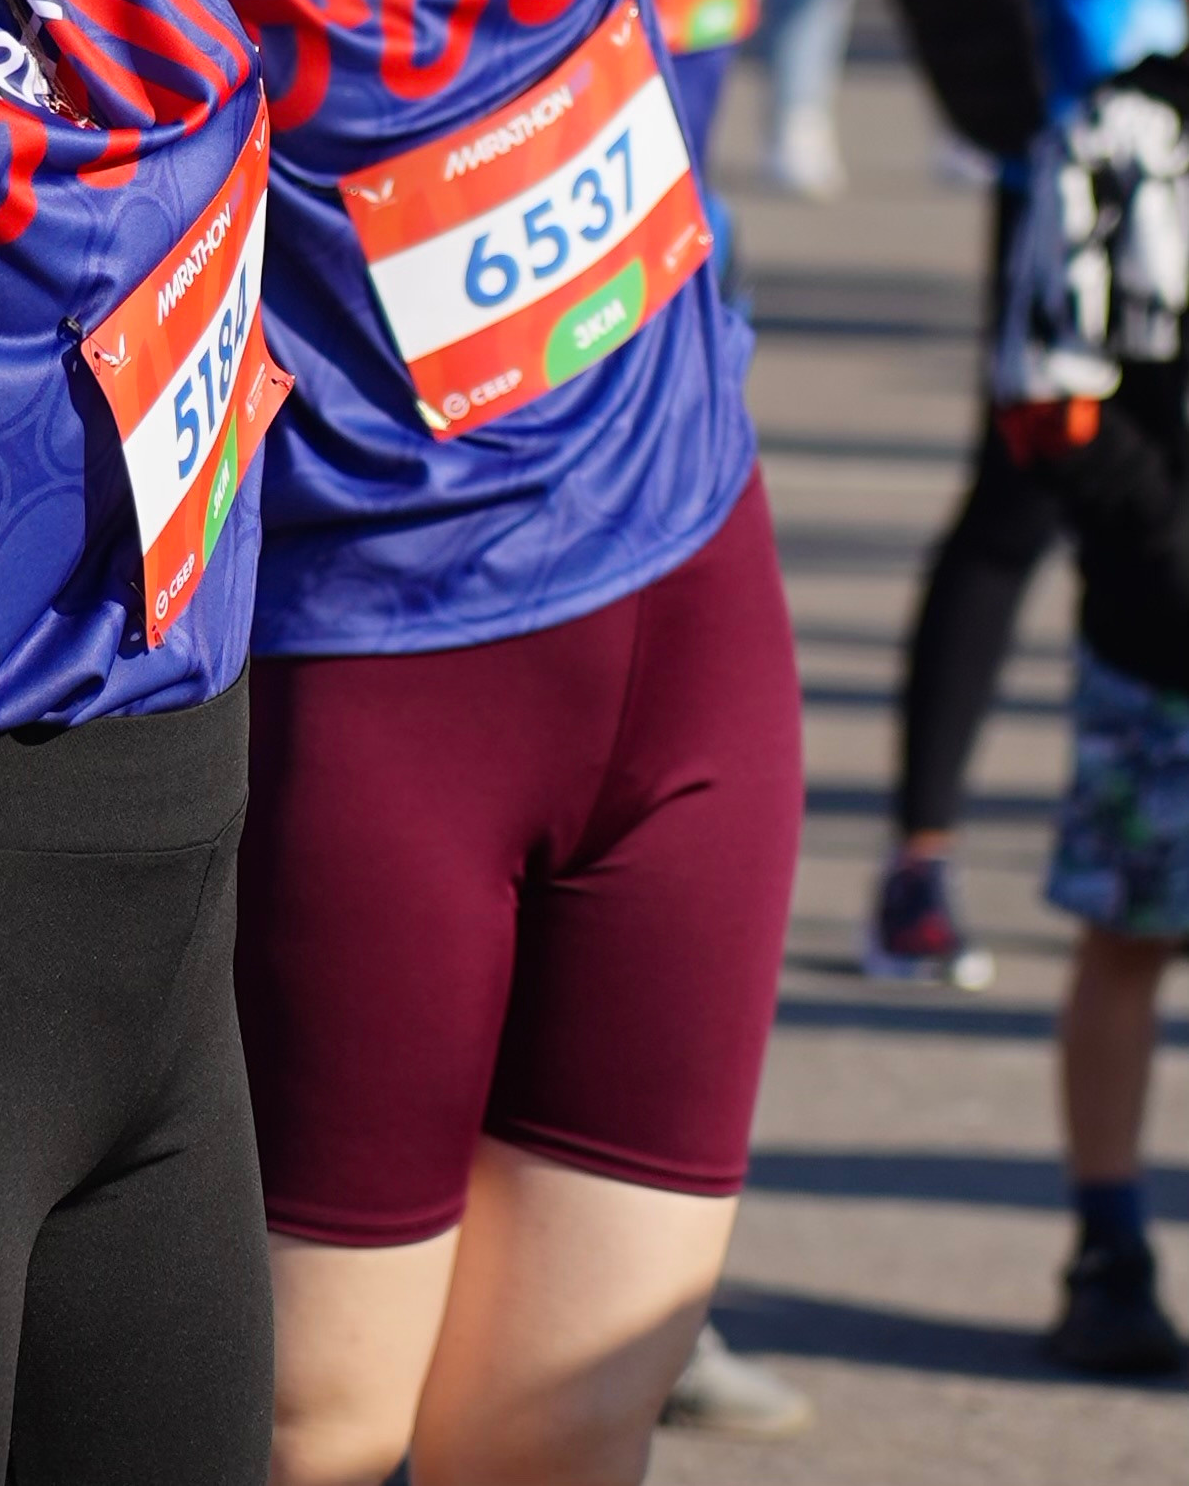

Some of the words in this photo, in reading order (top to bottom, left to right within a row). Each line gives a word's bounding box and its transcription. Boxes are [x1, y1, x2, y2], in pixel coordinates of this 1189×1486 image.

[443, 85, 574, 182] MARATHON
[157, 202, 232, 327] MARATHON
[464, 127, 632, 307] 6537
[173, 260, 247, 480] 5184
